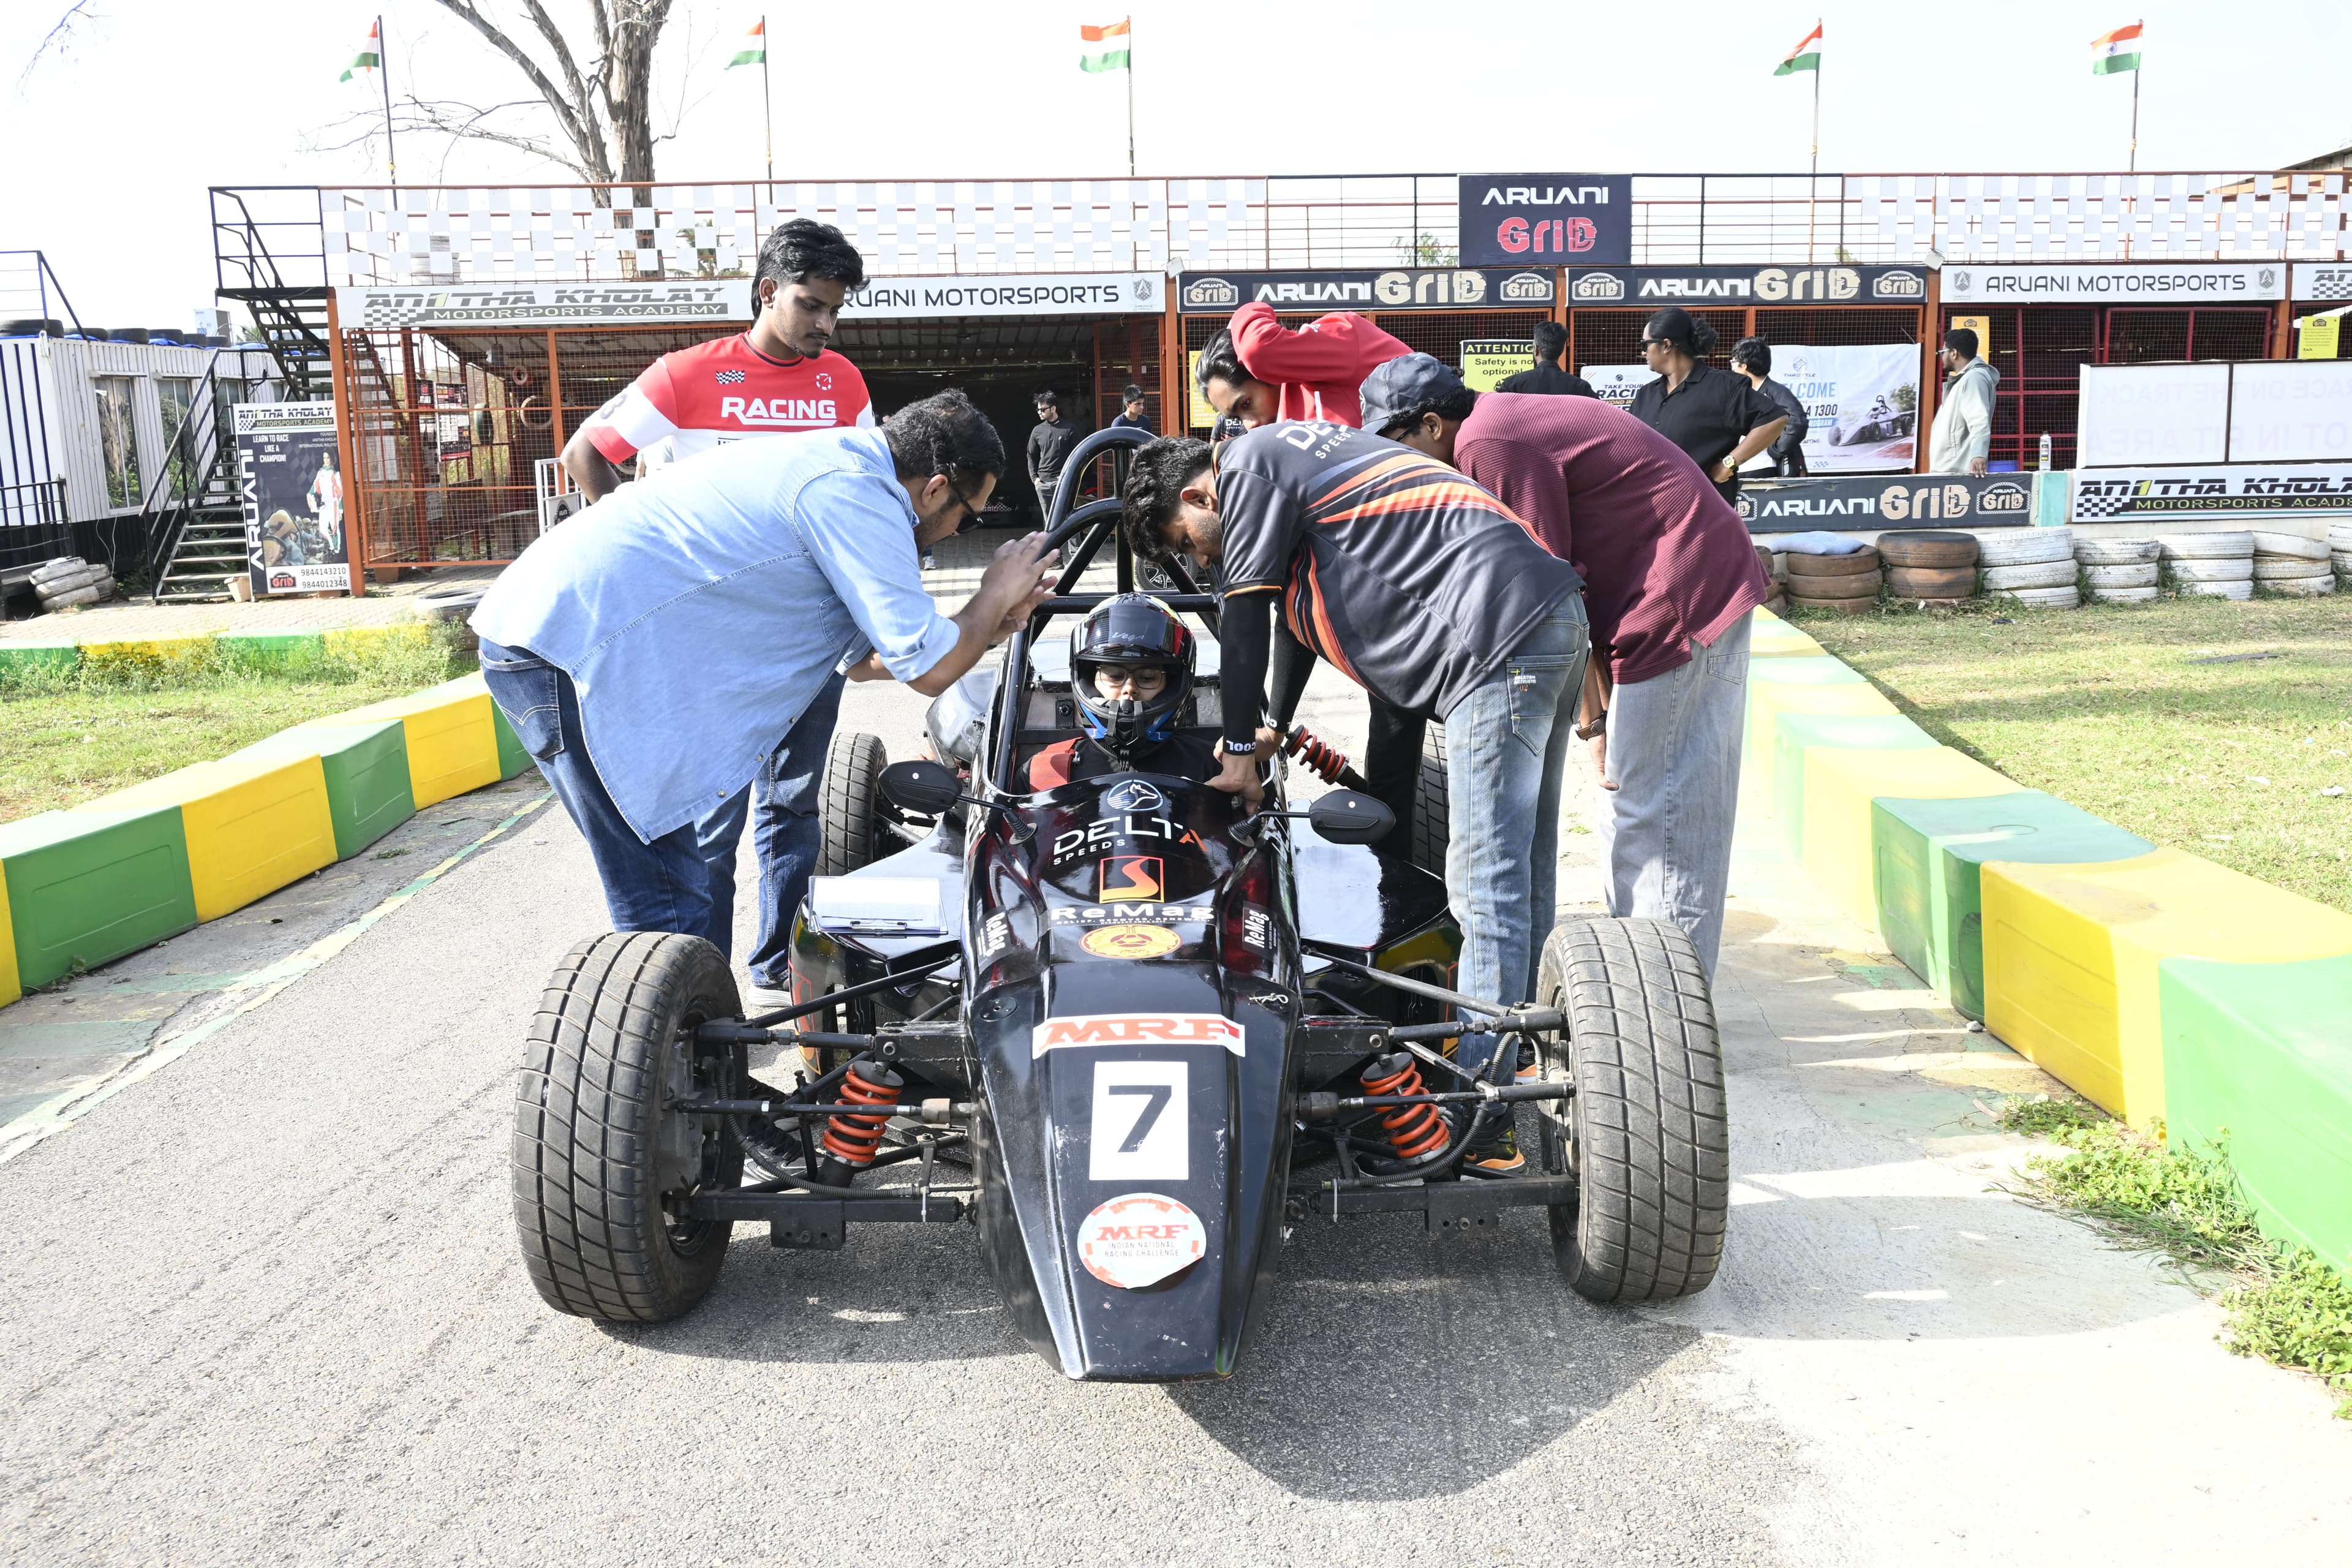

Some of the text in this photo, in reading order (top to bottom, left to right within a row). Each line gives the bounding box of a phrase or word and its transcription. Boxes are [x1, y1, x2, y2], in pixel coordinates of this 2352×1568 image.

[1482, 187, 1608, 205] ARUANI
[1255, 283, 1371, 301] ARUANI
[1638, 279, 1750, 297] ARUANI
[1986, 274, 2246, 292] ARUANI MOTORSPORTS
[554, 287, 725, 304] KHOLAY
[843, 285, 1120, 307] RUANI MOTORSPORTS
[434, 305, 722, 320] MOTORSPORTS ACADEMY
[288, 407, 333, 418] KHOLAY
[721, 396, 837, 424] RACING
[1815, 404, 1838, 417] 1300
[1315, 425, 1355, 459] SPEED
[2243, 477, 2352, 494] KHOLA
[240, 449, 265, 571] ARUANI
[1761, 497, 1875, 517] ARUANI
[2136, 496, 2352, 510] MOTORSPORTS ACADE
[301, 567, 346, 576] 9844143210
[302, 579, 347, 589] 9844012348
[1054, 815, 1208, 856] DELTA
[1053, 839, 1126, 865] SPEEDS
[1051, 903, 1215, 920] ReMag
[986, 911, 1009, 957] ReMag
[1244, 910, 1270, 949] ReMag
[1039, 1019, 1240, 1051] MRF
[1108, 1085, 1172, 1153] 7
[1096, 1224, 1189, 1241] MRF
